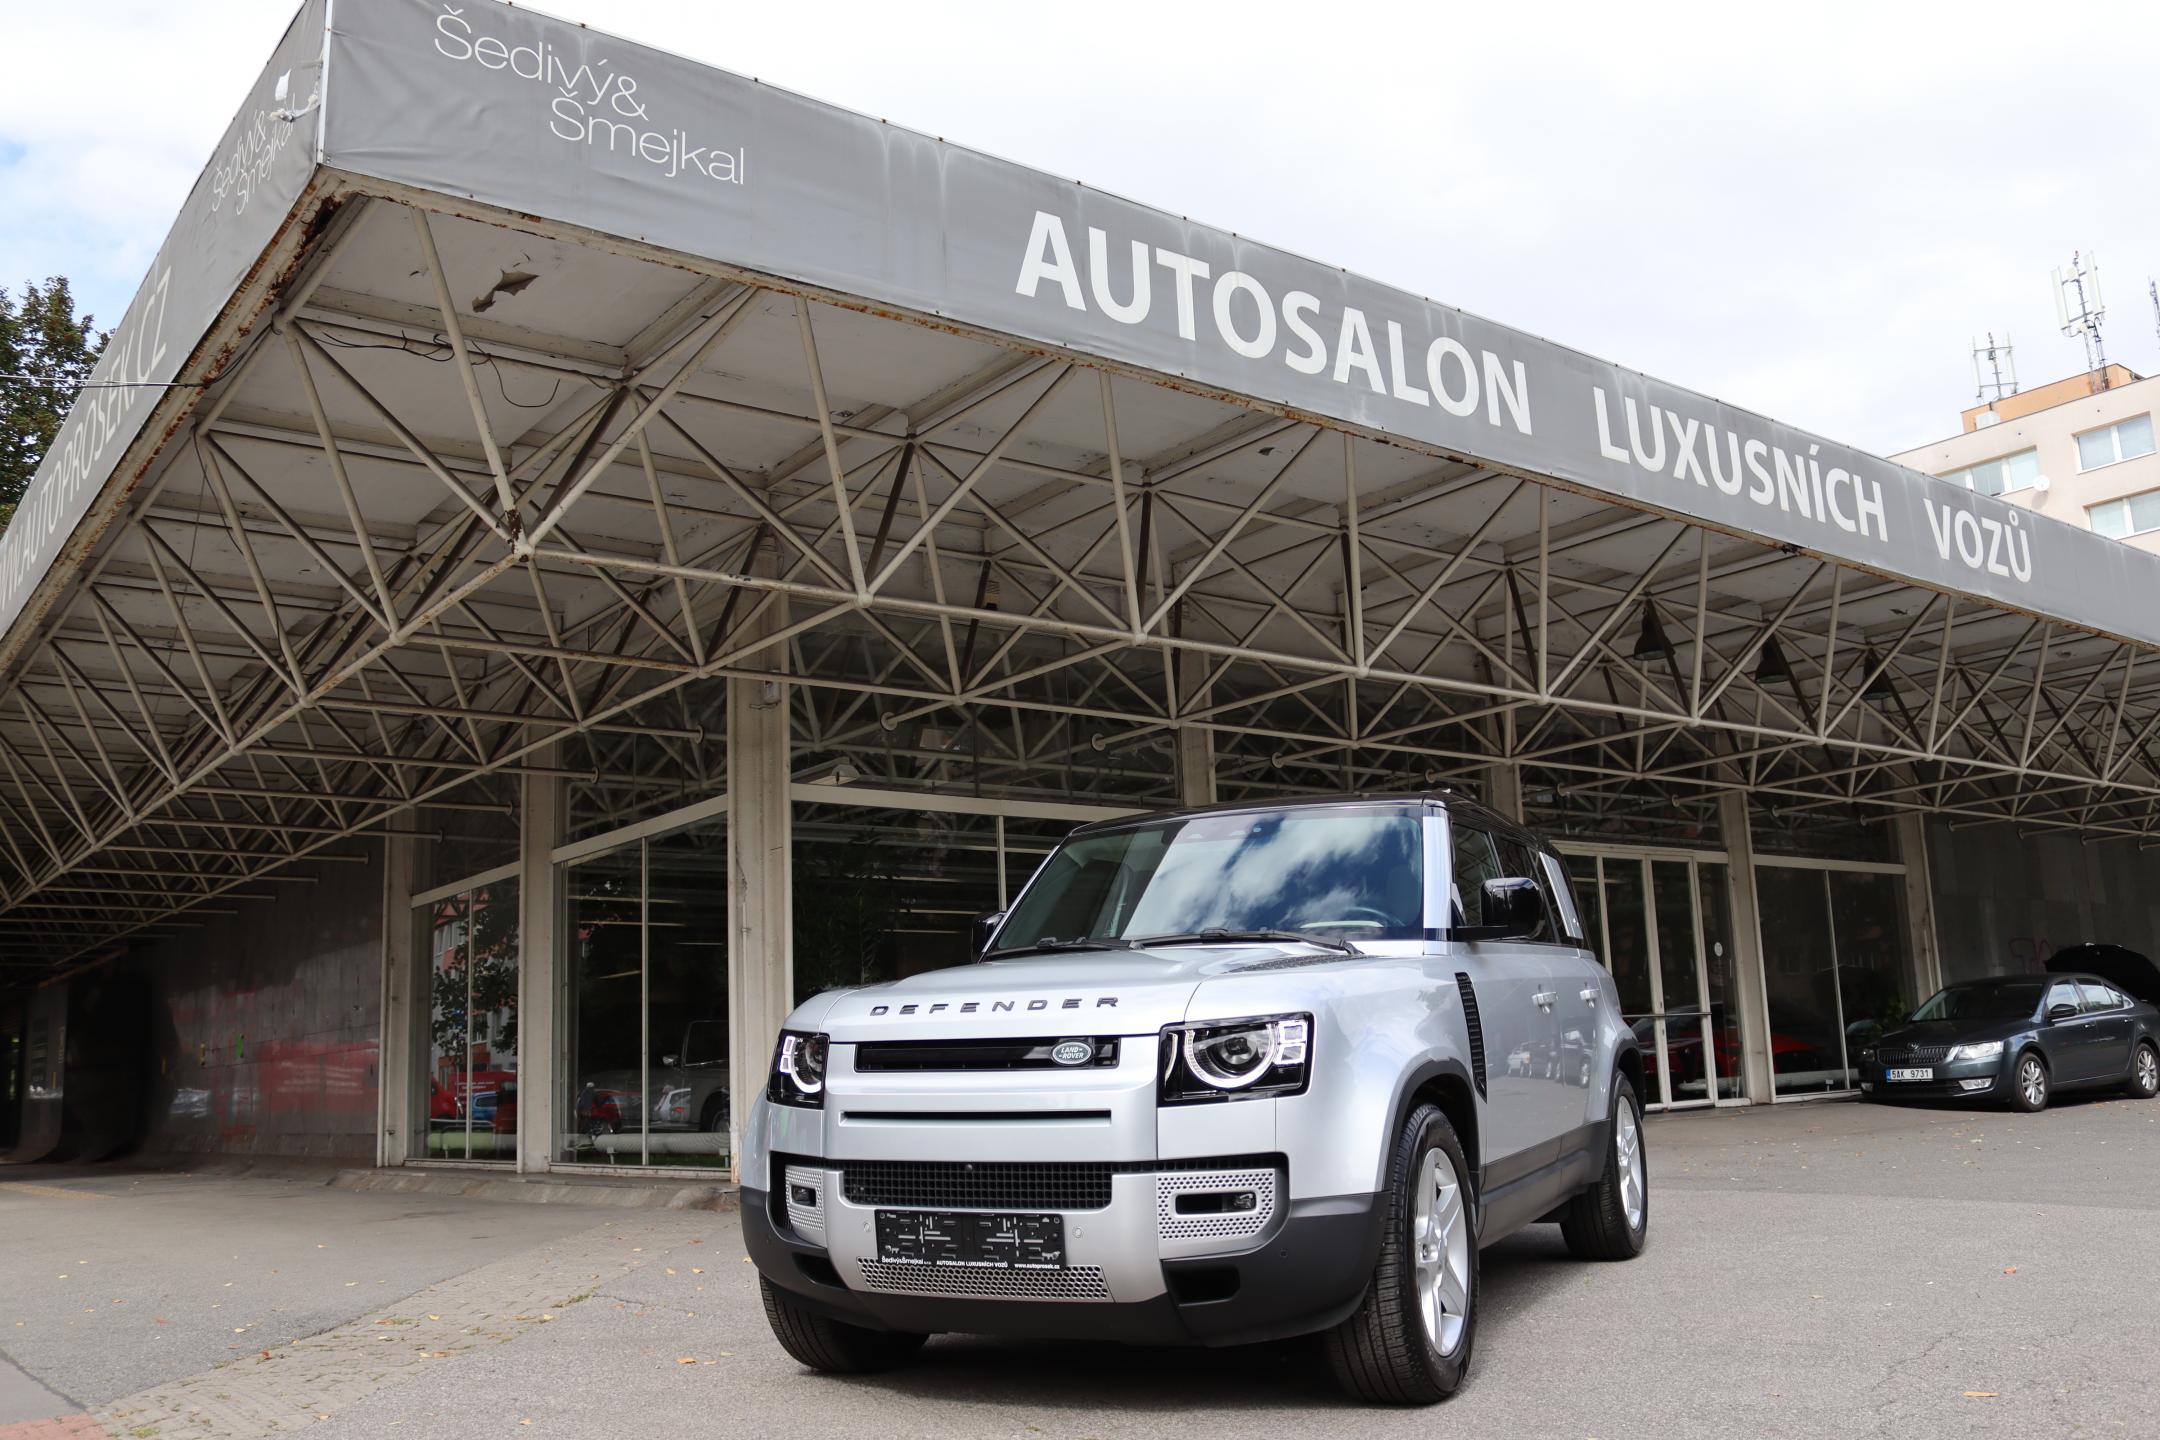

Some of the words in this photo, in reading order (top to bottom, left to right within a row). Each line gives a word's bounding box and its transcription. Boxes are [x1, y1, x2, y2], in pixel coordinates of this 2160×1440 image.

[434, 4, 649, 121] Šedivý&
[212, 108, 266, 212] Šedivý&
[236, 92, 296, 216] Šmejkal
[550, 86, 744, 185] Šmejkal
[1015, 210, 1532, 435] AUTOSALON
[1593, 387, 1888, 542] LUXUSNÍCH
[1923, 498, 2032, 582] VOZŮ
[869, 997, 1119, 1016] DEFENDER
[1892, 1070, 1905, 1079] 5AK
[1910, 1069, 1929, 1079] 9731
